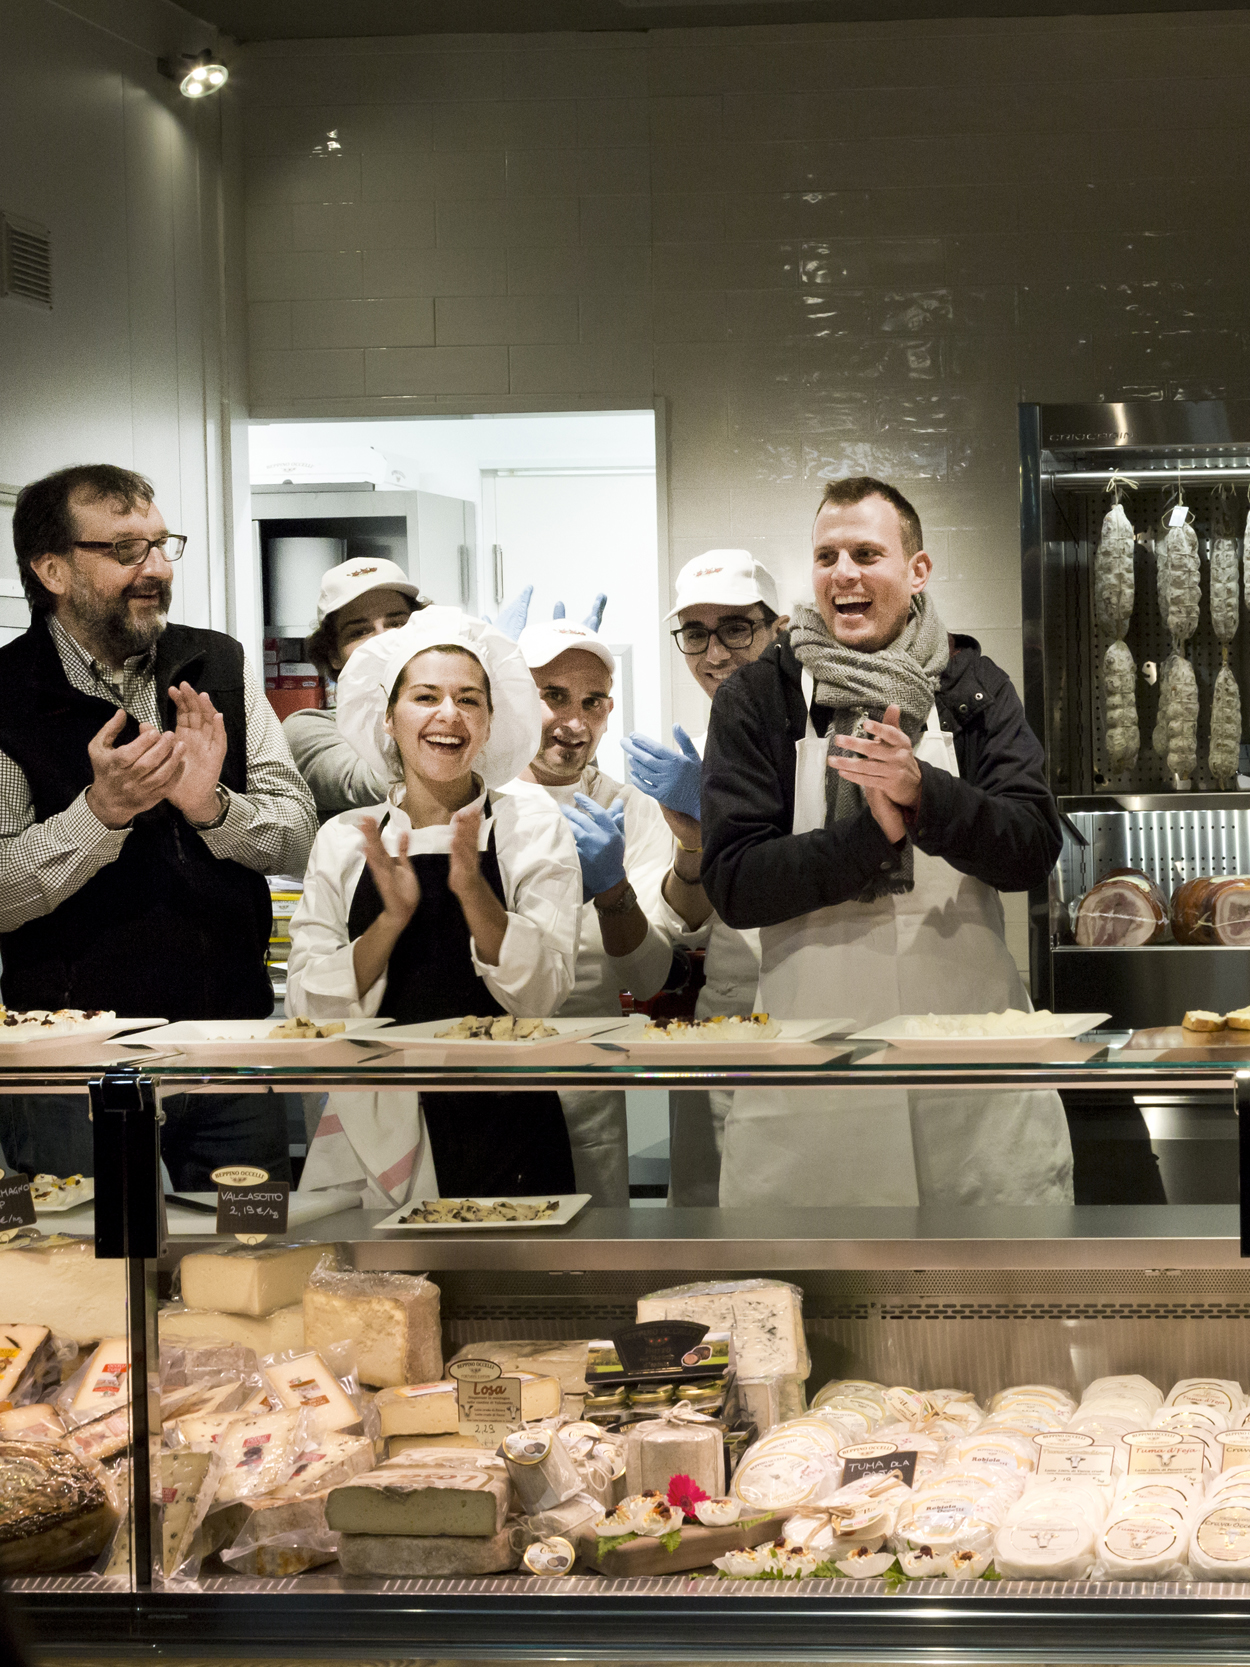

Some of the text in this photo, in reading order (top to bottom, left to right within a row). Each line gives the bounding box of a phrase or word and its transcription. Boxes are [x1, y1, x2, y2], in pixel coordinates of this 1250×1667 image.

[215, 1170, 265, 1179] BEPPINO OCCELLI
[221, 1191, 283, 1202] VALCASOTTO
[473, 1382, 507, 1396] Losa
[842, 1443, 893, 1455] BEPPINO OCCELLI
[849, 1460, 884, 1472] TUMA
